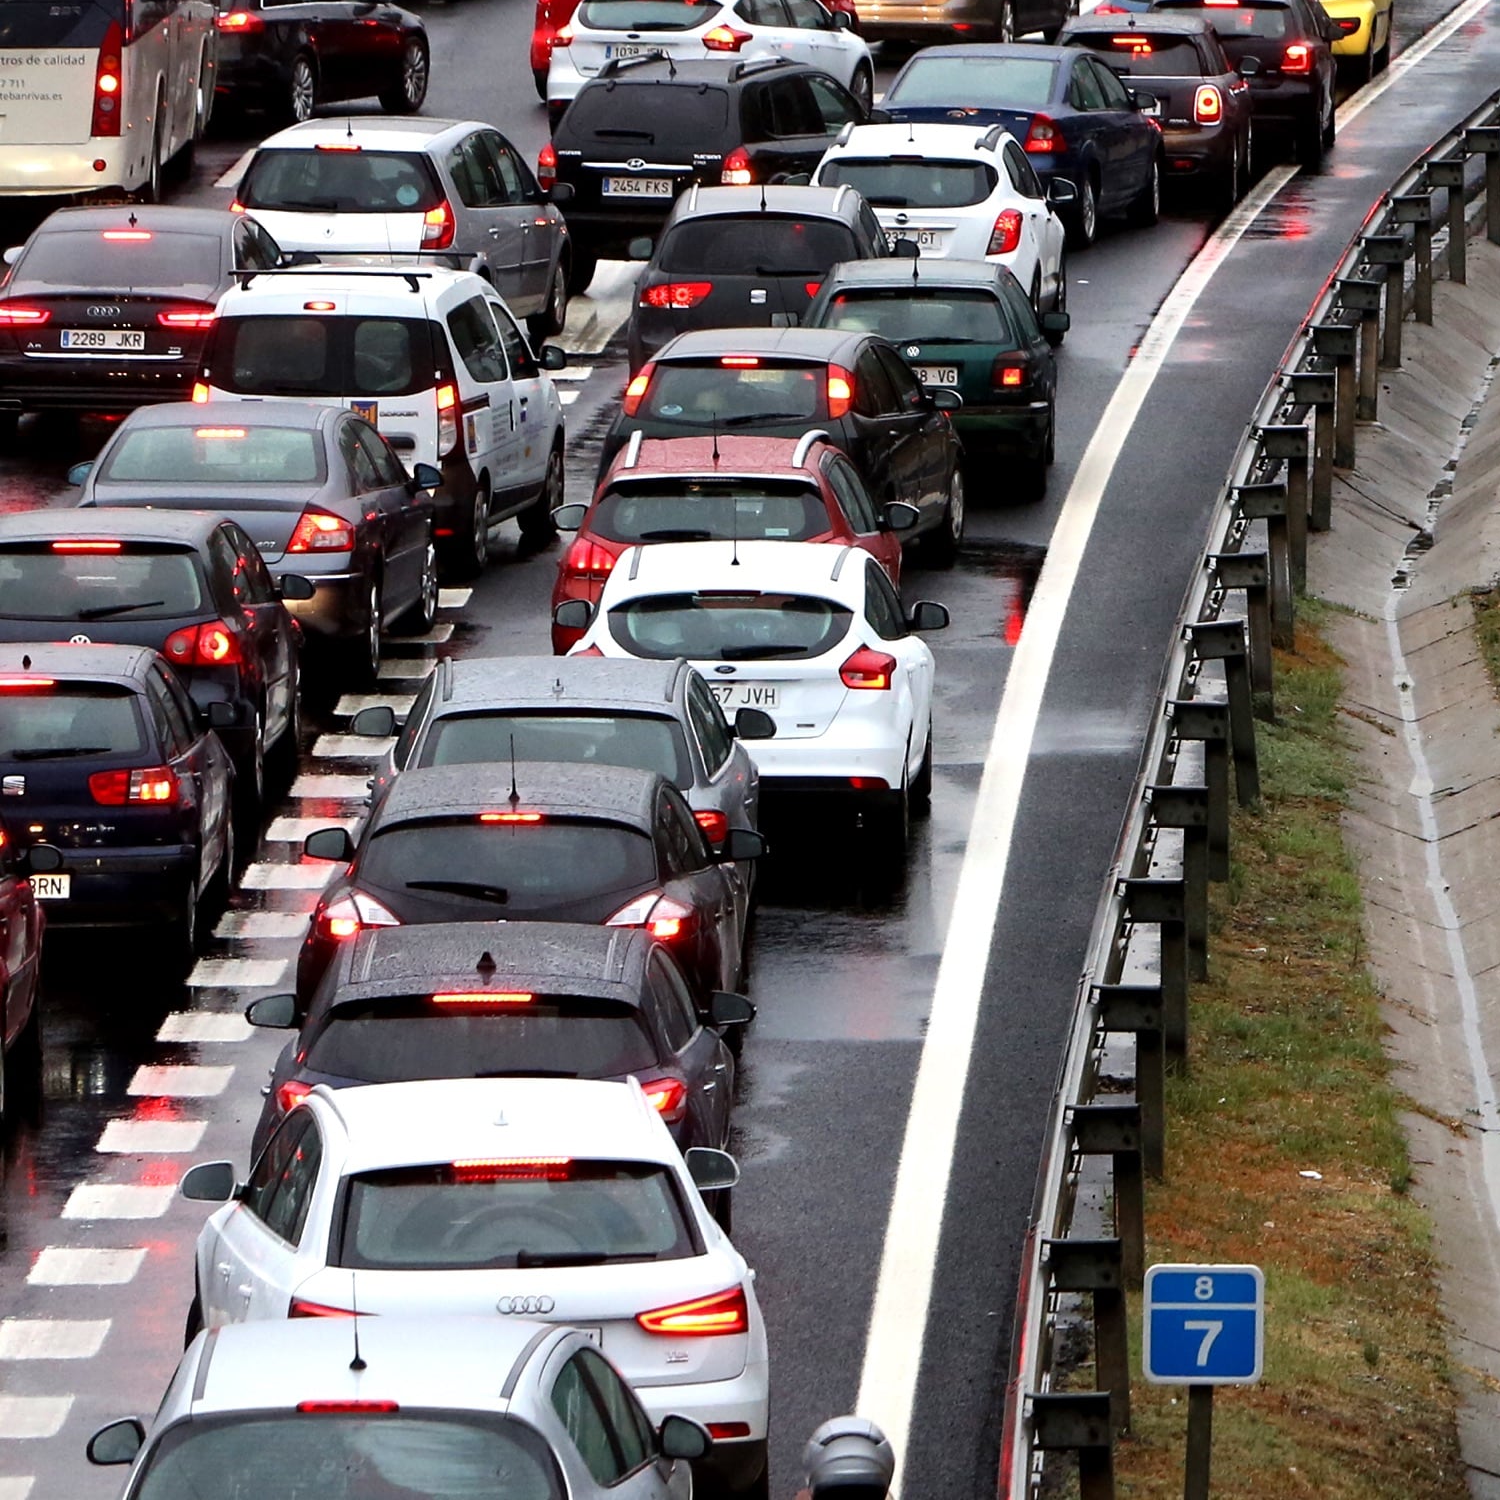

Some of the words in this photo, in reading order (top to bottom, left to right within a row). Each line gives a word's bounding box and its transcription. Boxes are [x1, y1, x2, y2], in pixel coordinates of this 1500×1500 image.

[26, 54, 41, 66] de
[44, 54, 86, 66] calidad
[613, 179, 640, 193] 2454
[645, 180, 669, 194] FKS
[72, 331, 106, 347] 2289
[116, 332, 142, 347] JKR
[742, 687, 776, 705] JVH
[1195, 1276, 1213, 1300] 8
[1184, 1320, 1223, 1367] 7
